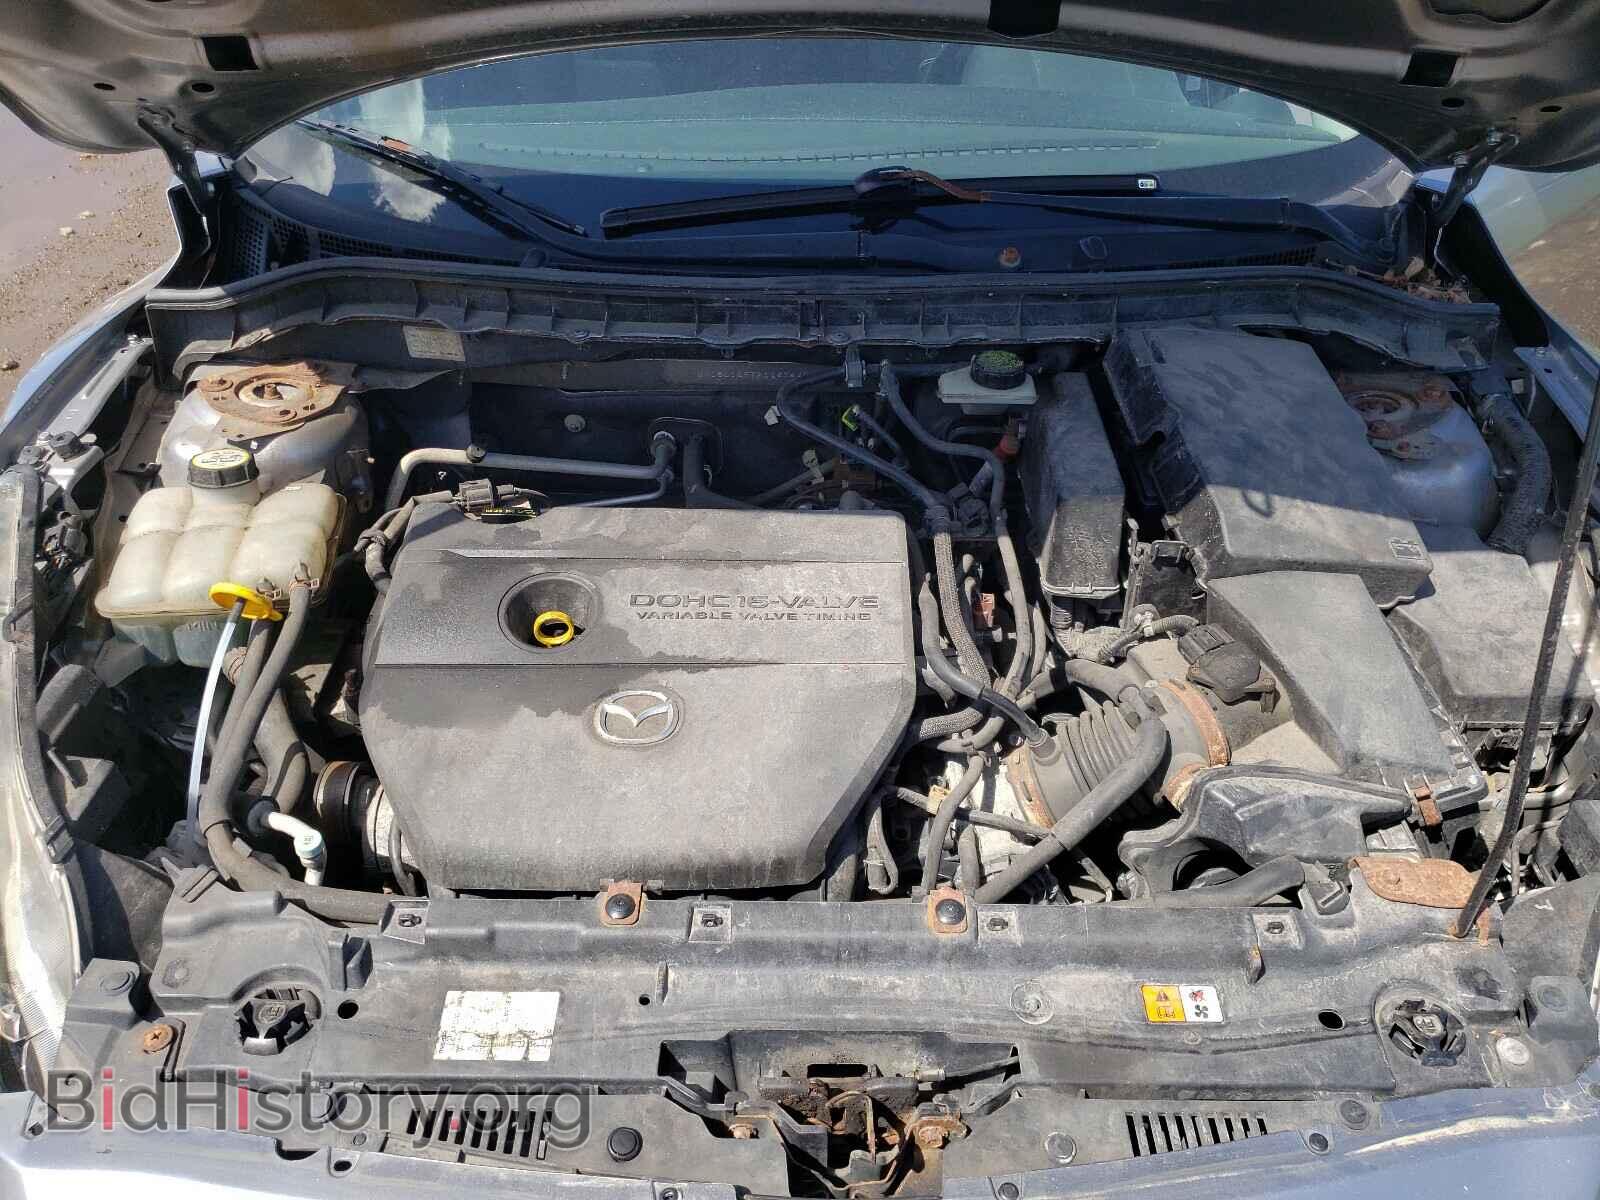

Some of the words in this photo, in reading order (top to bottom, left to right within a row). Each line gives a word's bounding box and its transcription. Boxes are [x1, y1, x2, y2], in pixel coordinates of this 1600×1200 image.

[629, 593, 731, 608] DOHC
[736, 593, 880, 609] 16-VALVE
[636, 610, 734, 621] VARIABLE
[739, 611, 800, 621] VALVE
[803, 611, 872, 621] TIMING
